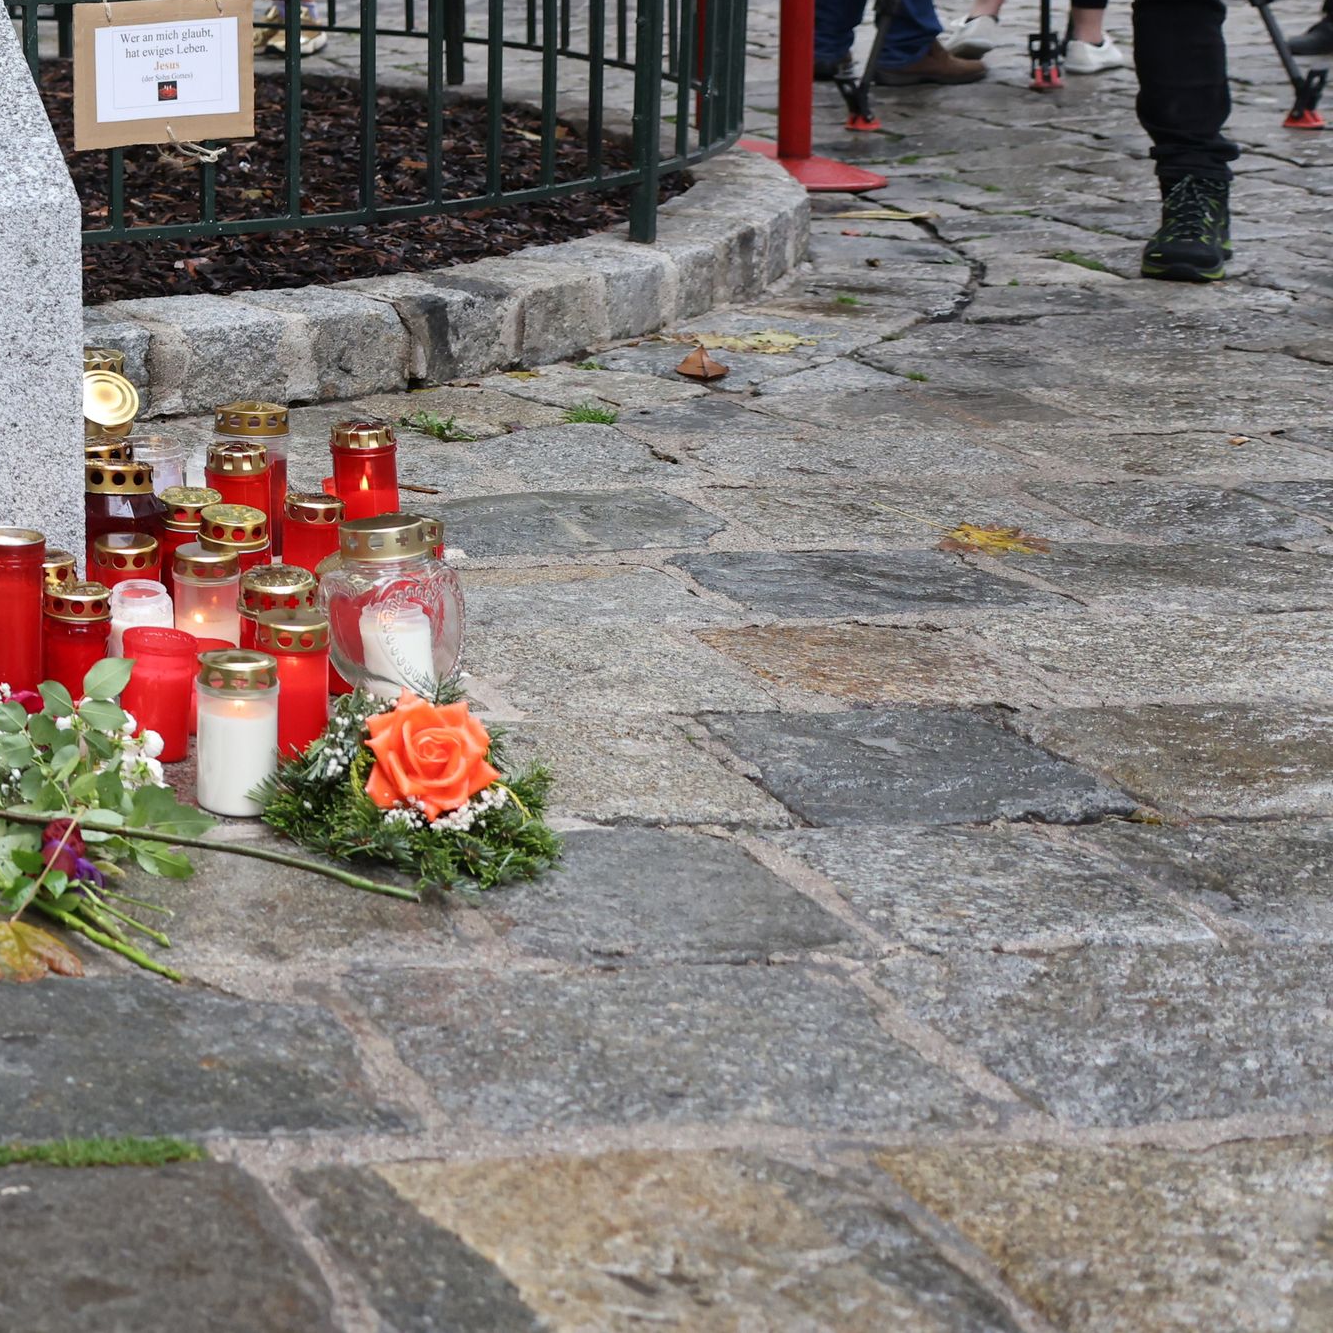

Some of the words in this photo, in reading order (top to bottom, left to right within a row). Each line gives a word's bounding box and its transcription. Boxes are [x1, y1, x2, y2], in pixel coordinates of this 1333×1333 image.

[120, 33, 141, 45] Wer
[142, 34, 154, 43] an
[156, 29, 179, 41] mich
[181, 26, 214, 41] glaubt,
[125, 48, 140, 59] hat
[142, 46, 174, 60] ewiges
[177, 43, 209, 55] Leben.
[153, 61, 180, 71] Jesus
